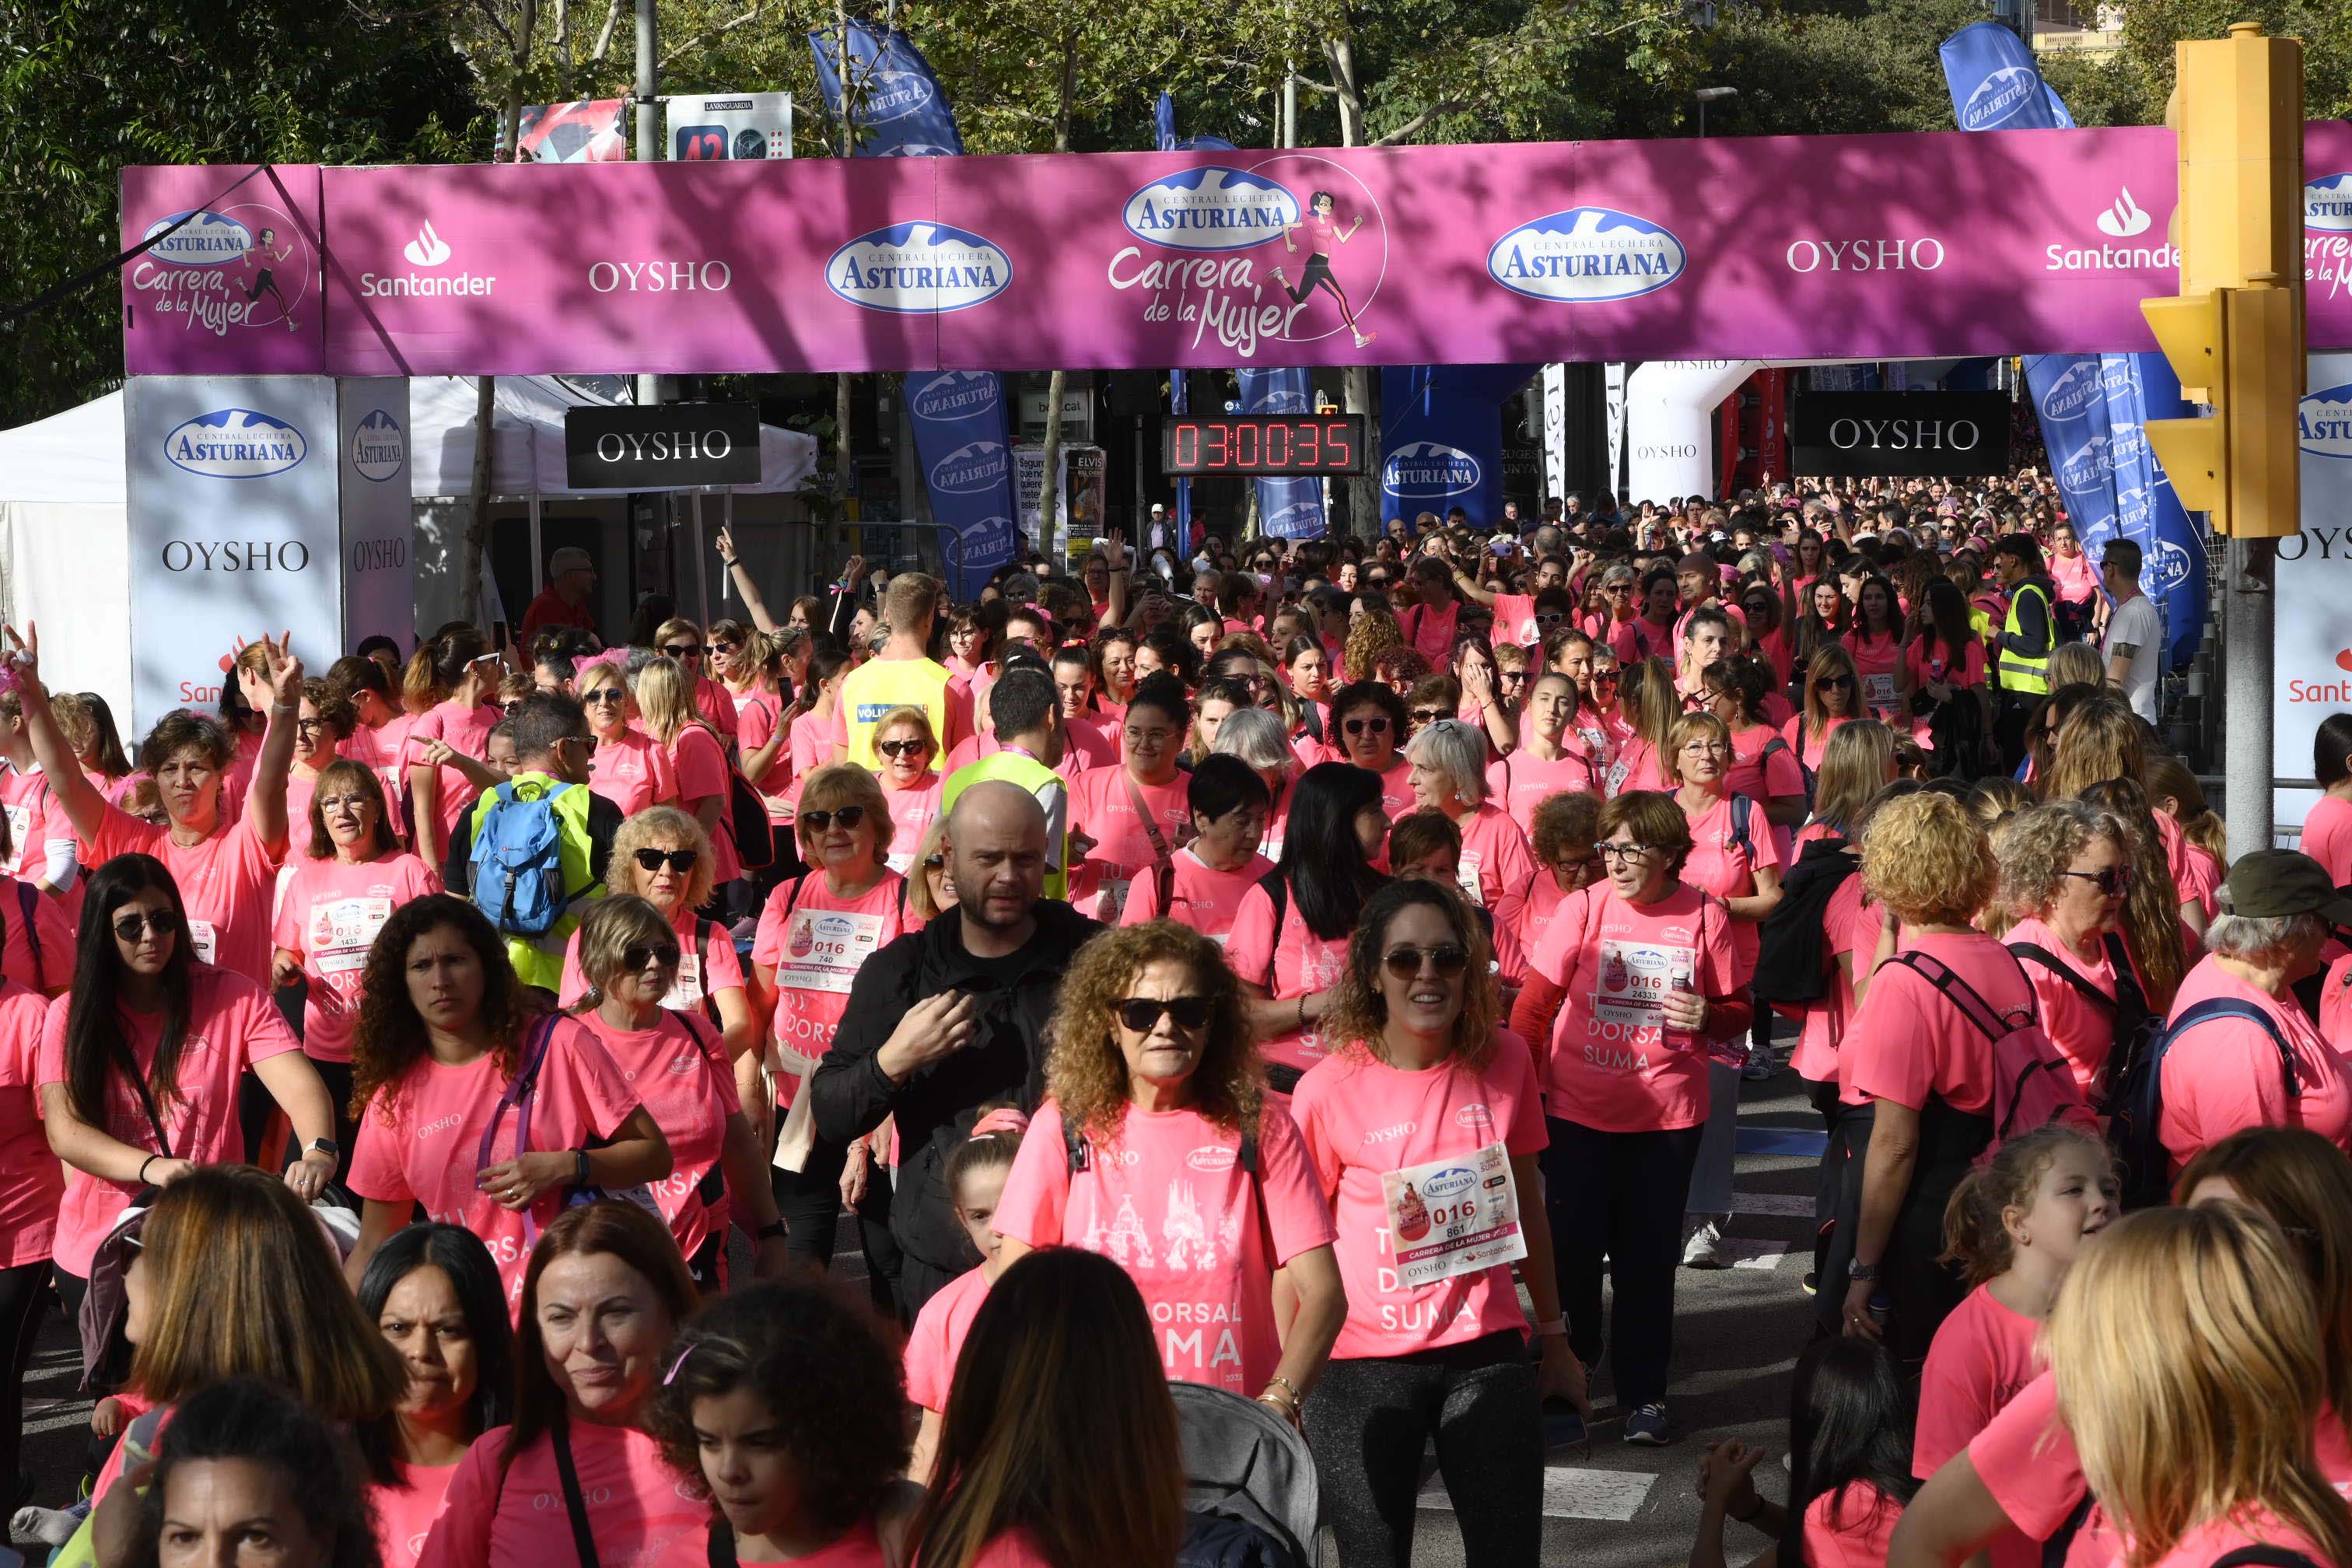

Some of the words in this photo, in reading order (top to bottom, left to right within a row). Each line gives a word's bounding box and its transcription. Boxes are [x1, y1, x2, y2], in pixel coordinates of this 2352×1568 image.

[1164, 195, 1220, 204] CENTRAL
[1224, 194, 1281, 203] LECHERA
[1137, 198, 1285, 230] ASTURIANA
[152, 231, 245, 250] ASTURIANA
[1534, 240, 1594, 250] CENTRAL
[1600, 238, 1664, 248] LECHERA
[868, 252, 926, 261] CENTRAL
[1108, 246, 1255, 290] Carrera
[1503, 244, 1671, 278] ASTURIANA
[1787, 238, 1944, 274] OYSHO
[2046, 243, 2179, 271] Santande
[133, 262, 225, 291] Carrera
[589, 261, 732, 292] OYSHO
[840, 256, 997, 290] ASTURIANA
[2318, 258, 2333, 281] la
[361, 273, 496, 297] Santander
[156, 292, 173, 312] de
[176, 290, 188, 312] la
[187, 288, 259, 337] Mujer
[1144, 292, 1171, 322] de
[1177, 291, 1196, 321] la
[1192, 284, 1308, 358] Mujer
[1175, 424, 1350, 467] 03:00:35
[1829, 418, 1980, 450] OYSHO
[176, 434, 296, 461] ASTURIANA
[356, 436, 401, 464] ASTURIANA
[597, 430, 732, 463] OYSHO
[1637, 444, 1696, 460] OYSHO
[1078, 457, 1102, 467] ELVIS
[1385, 464, 1473, 486] ASTURIANA
[162, 541, 310, 572] OYSHO
[353, 537, 405, 573] OYSHO
[1101, 863, 1123, 880] TU
[1179, 900, 1214, 909] OSHO
[817, 923, 852, 934] ASTURIANA
[320, 948, 341, 957] CARRERA
[341, 938, 358, 947] 1433
[814, 941, 845, 955] 016
[819, 955, 834, 964] 740
[1629, 956, 1665, 967] ASTURIANA
[784, 974, 812, 983] OYSHO
[1630, 975, 1662, 989] 016
[1607, 998, 1634, 1006] CARRERA
[1632, 989, 1657, 1000] 24333
[1603, 1010, 1633, 1020] OYSHO
[1587, 1016, 1663, 1045] DORSA
[1583, 1044, 1650, 1071] SUMA
[417, 1113, 462, 1139] OYSHO
[1363, 1122, 1416, 1145] OYSHO
[1480, 1161, 1502, 1173] SUMA
[1428, 1176, 1474, 1195] ASTURIANA
[1433, 1200, 1476, 1225] 016
[1447, 1223, 1465, 1238] 861
[1409, 1245, 1444, 1260] CARRERA
[1444, 1242, 1455, 1251] DE
[1455, 1239, 1465, 1248] LA
[1466, 1232, 1491, 1244] MUJER
[1408, 1260, 1447, 1278] OYSHO
[1476, 1243, 1514, 1260] Santander
[1151, 1301, 1242, 1324] ORSAL
[1381, 1295, 1477, 1331] SUMA
[1167, 1328, 1242, 1369] MA
[533, 1486, 611, 1511] OYHO
